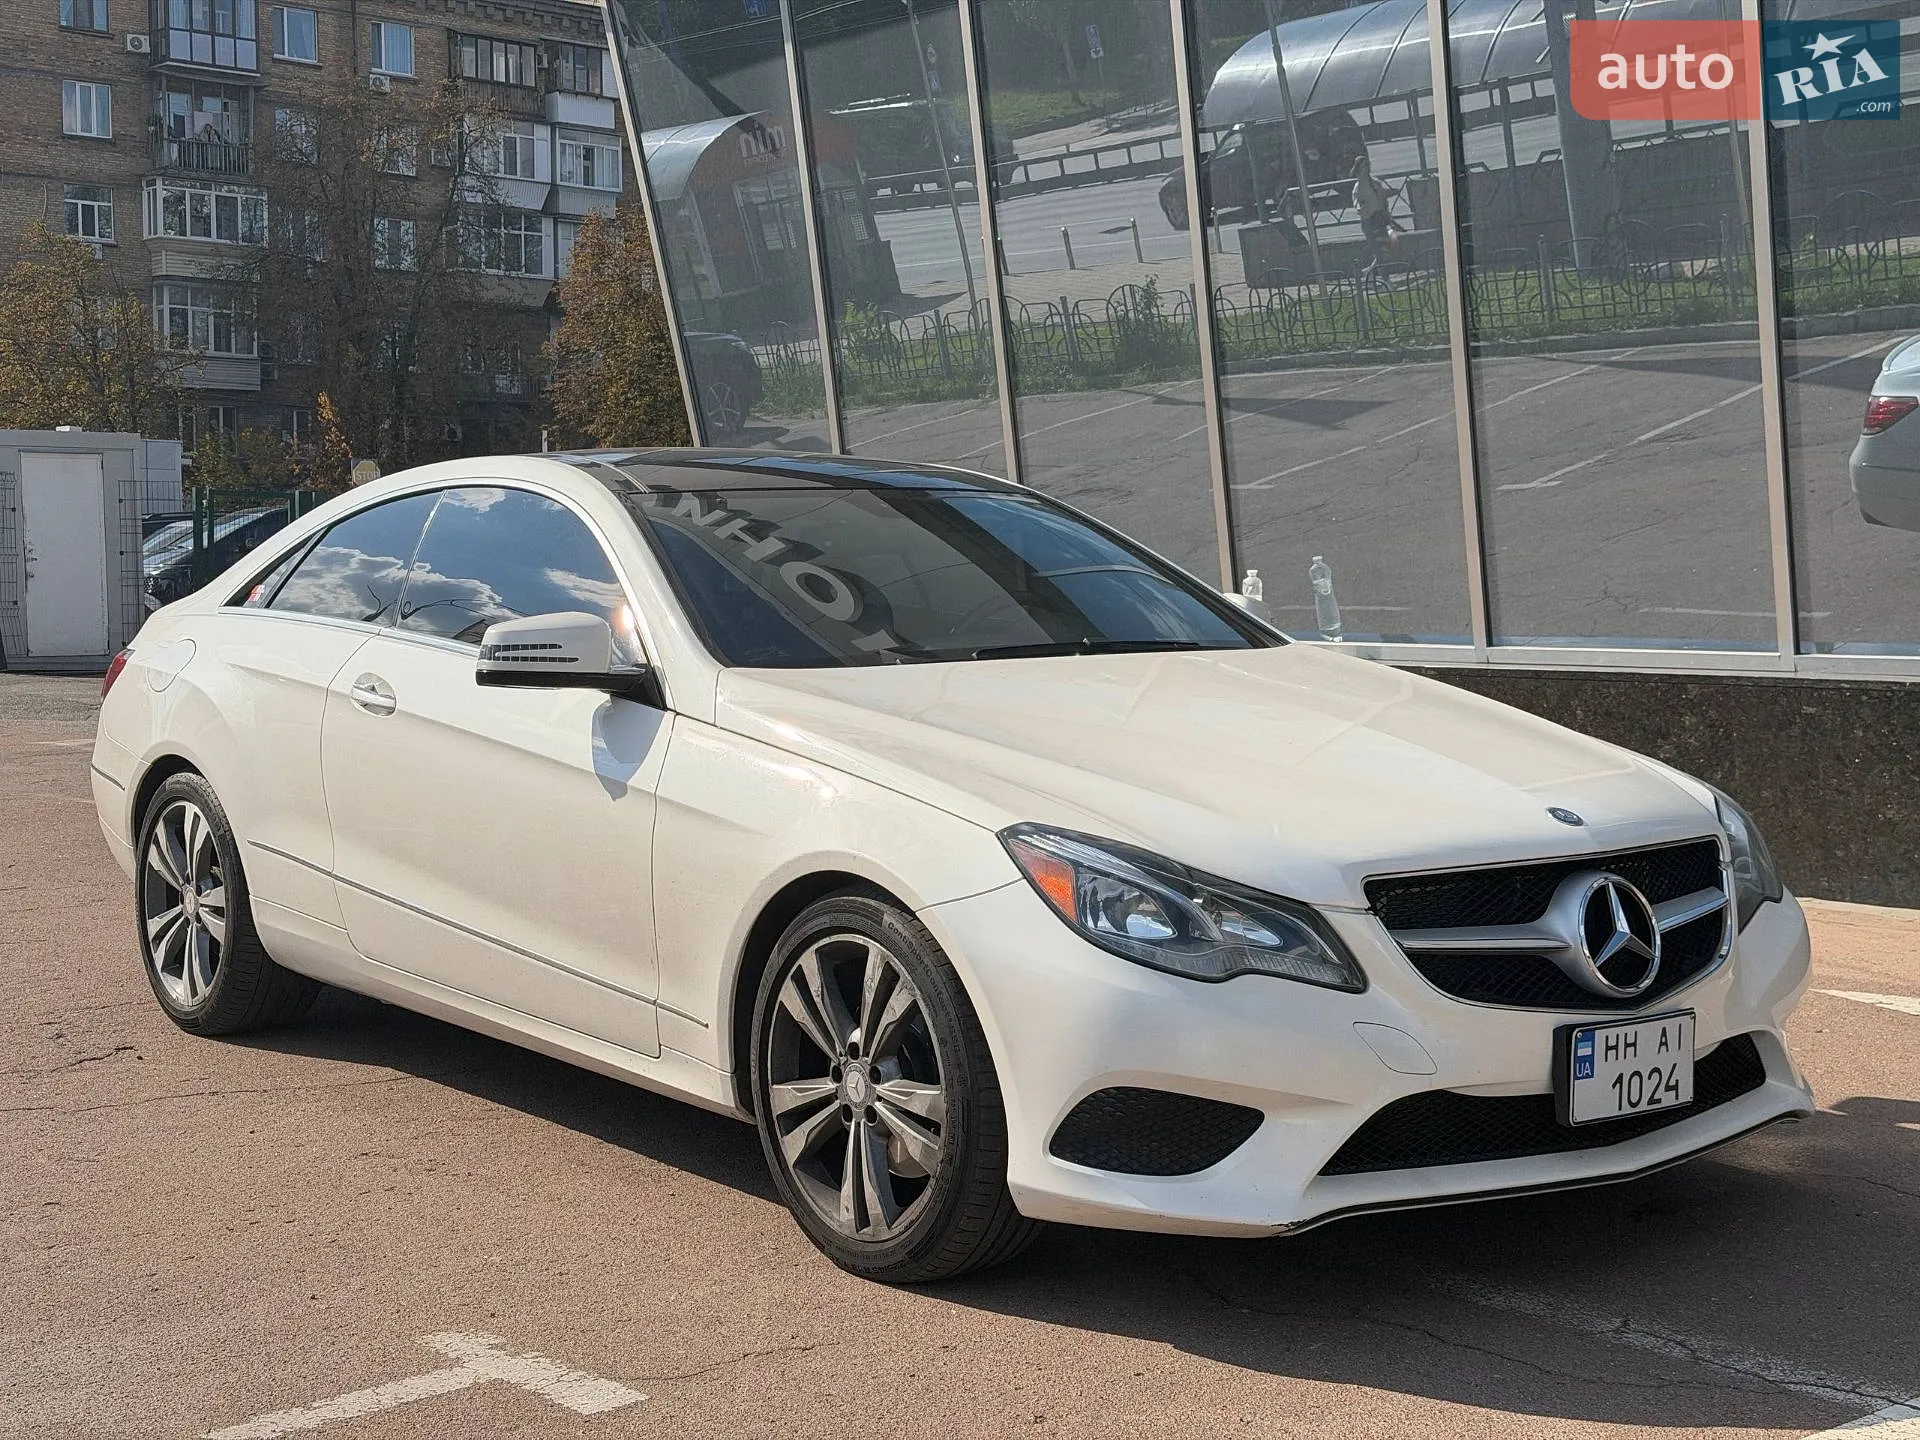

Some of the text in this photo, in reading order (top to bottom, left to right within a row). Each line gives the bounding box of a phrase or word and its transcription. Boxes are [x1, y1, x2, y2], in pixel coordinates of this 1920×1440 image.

[1604, 1023, 1682, 1062] HH AI
[1576, 1062, 1592, 1077] UA
[1611, 1063, 1680, 1111] 1024
